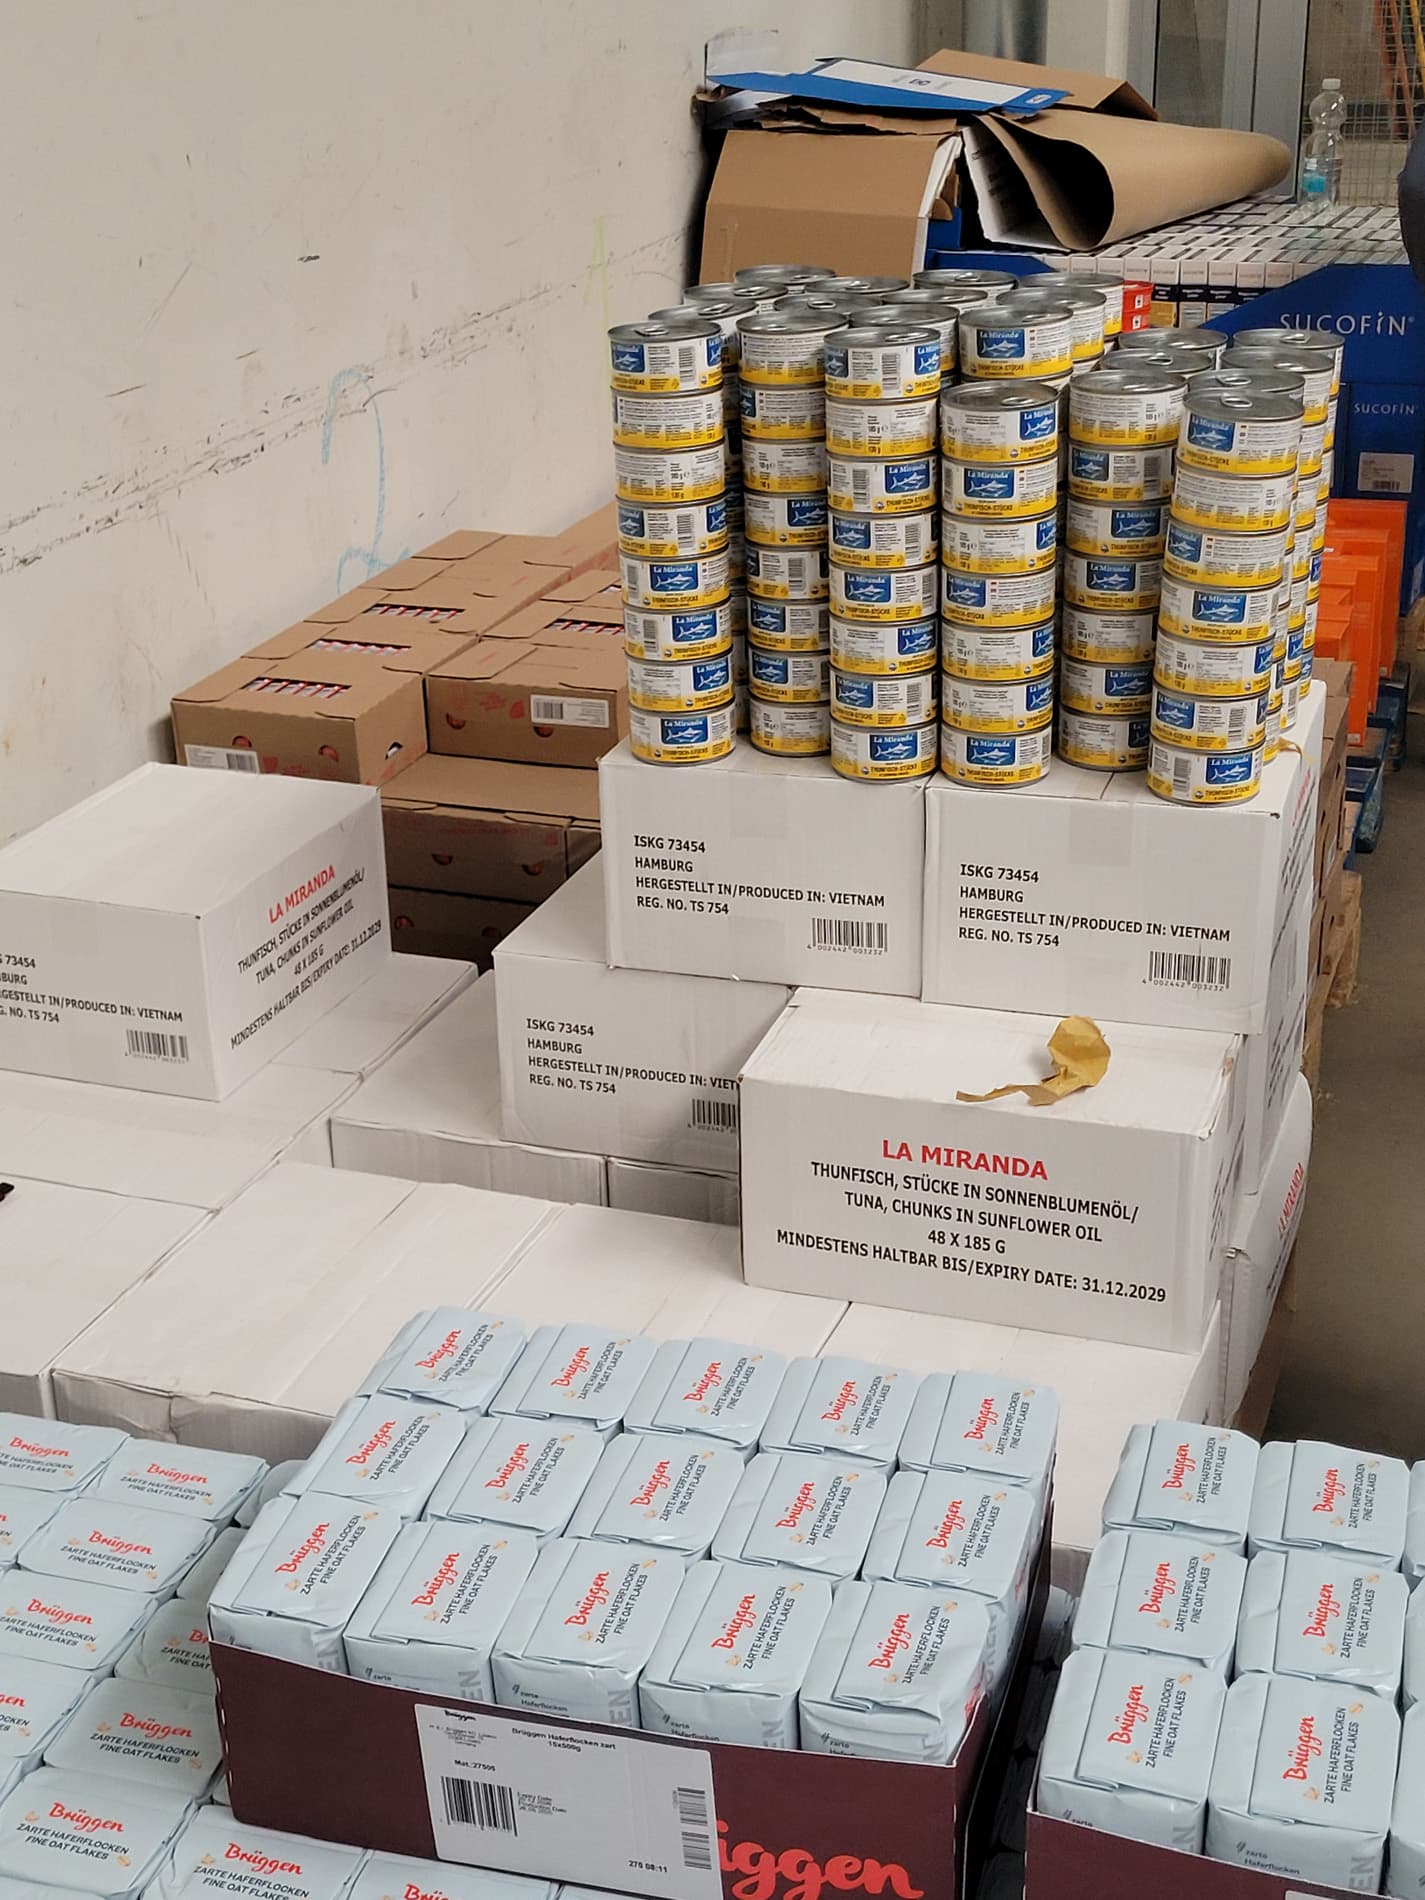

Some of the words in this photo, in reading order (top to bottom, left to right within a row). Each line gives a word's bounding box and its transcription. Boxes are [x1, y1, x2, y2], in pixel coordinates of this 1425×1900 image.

[634, 835, 664, 849] ISKG
[668, 839, 706, 853] 73454
[635, 857, 693, 872] HAMBURG
[961, 864, 993, 878] ISKG
[998, 868, 1039, 882] 73454
[269, 902, 284, 924] LA
[285, 864, 336, 912] MIRANDA
[636, 876, 714, 894] HERGESTELLT
[718, 884, 803, 901] IN/PRODUCED
[808, 891, 825, 903] IN:
[829, 892, 884, 907] VIETNAM
[637, 896, 663, 909] REG.
[667, 898, 687, 911] NO.
[690, 900, 704, 912] TS
[708, 902, 729, 914] 754
[960, 886, 1023, 902] HAMBURG
[959, 907, 1046, 925] HERGESTELLT
[1049, 914, 1142, 934] IN/PRODUCED
[1146, 922, 1166, 935] IN:
[1171, 925, 1230, 941] VIETNAM
[959, 927, 987, 940] REG.
[992, 930, 1013, 943] NO.
[1018, 932, 1032, 944] TS
[1037, 933, 1059, 946] 754
[5, 955, 36, 968] 73454
[0, 972, 27, 985] BURG
[0, 989, 46, 1004] GESTELLT
[49, 995, 117, 1013] IN/PRODUCED
[120, 1005, 135, 1016] IN:
[137, 1008, 182, 1022] VIETNAM
[9, 1007, 26, 1018] NO.
[29, 1009, 40, 1019] TS
[42, 1011, 59, 1023] 754
[527, 1018, 555, 1032] ISKG
[559, 1023, 594, 1036] 73454
[528, 1038, 582, 1054] HAMBURG
[529, 1056, 602, 1075] HERGESTELLT
[606, 1064, 686, 1084] IN/PRODUCED
[690, 1074, 707, 1087] IN:
[530, 1074, 554, 1087] REG.
[557, 1078, 577, 1089] NO.
[580, 1080, 593, 1091] TS
[596, 1082, 616, 1094] 754
[882, 1139, 913, 1162] LA
[922, 1145, 1048, 1181] MIRANDA
[811, 1161, 899, 1190] THUNFISCH,
[903, 1171, 958, 1197] STÜCKE
[964, 1182, 981, 1199] IN
[986, 1185, 1138, 1224] SONNENBLUMENÖL/
[845, 1191, 888, 1214] TUNA,
[892, 1199, 952, 1221] CHUNKS
[956, 1207, 973, 1224] IN
[978, 1212, 1071, 1239] SUNFLOWER
[1076, 1224, 1103, 1242] OIL
[927, 1229, 946, 1245] 48
[950, 1232, 960, 1247] X
[964, 1234, 992, 1251] 185
[996, 1239, 1005, 1254] G
[776, 1229, 869, 1257] MINDESTENS
[872, 1245, 938, 1268] HALTBAR
[942, 1256, 1030, 1283] BIS/EXPIRY
[1034, 1269, 1077, 1289] DATE:
[1082, 1277, 1166, 1302] 31.12.2029
[275, 1522, 330, 1572] Brüggen
[300, 1566, 323, 1595] ZARTE
[317, 1515, 361, 1570] HAFERFLOCKEN
[320, 1567, 337, 1584] FINE
[343, 1526, 366, 1552] FLAKES
[711, 1593, 757, 1649] Brüggen
[743, 1643, 762, 1669] ZARTE
[755, 1586, 786, 1642] HAFERFLOCKEN
[761, 1642, 776, 1660] FINE
[776, 1598, 795, 1626] FLAKES
[120, 1712, 192, 1739] Brüggen
[1328, 1707, 1346, 1773] HAFERFLOCKEN
[1346, 1721, 1359, 1753] FLAKES
[90, 1733, 122, 1744] ZARTE
[123, 1737, 200, 1757] HAFERFLOCKEN
[100, 1744, 121, 1752] FINE
[143, 1751, 181, 1763] FLAKES
[1282, 1716, 1322, 1780] Brüggen
[1324, 1773, 1337, 1804] ZARTE
[1341, 1772, 1352, 1792] FINE
[48, 1802, 124, 1833] Brüggen
[16, 1823, 51, 1836] ZARTE
[50, 1829, 129, 1855] HAFERFLOCKEN
[25, 1835, 49, 1846] FINE
[70, 1844, 109, 1860] FLAKES
